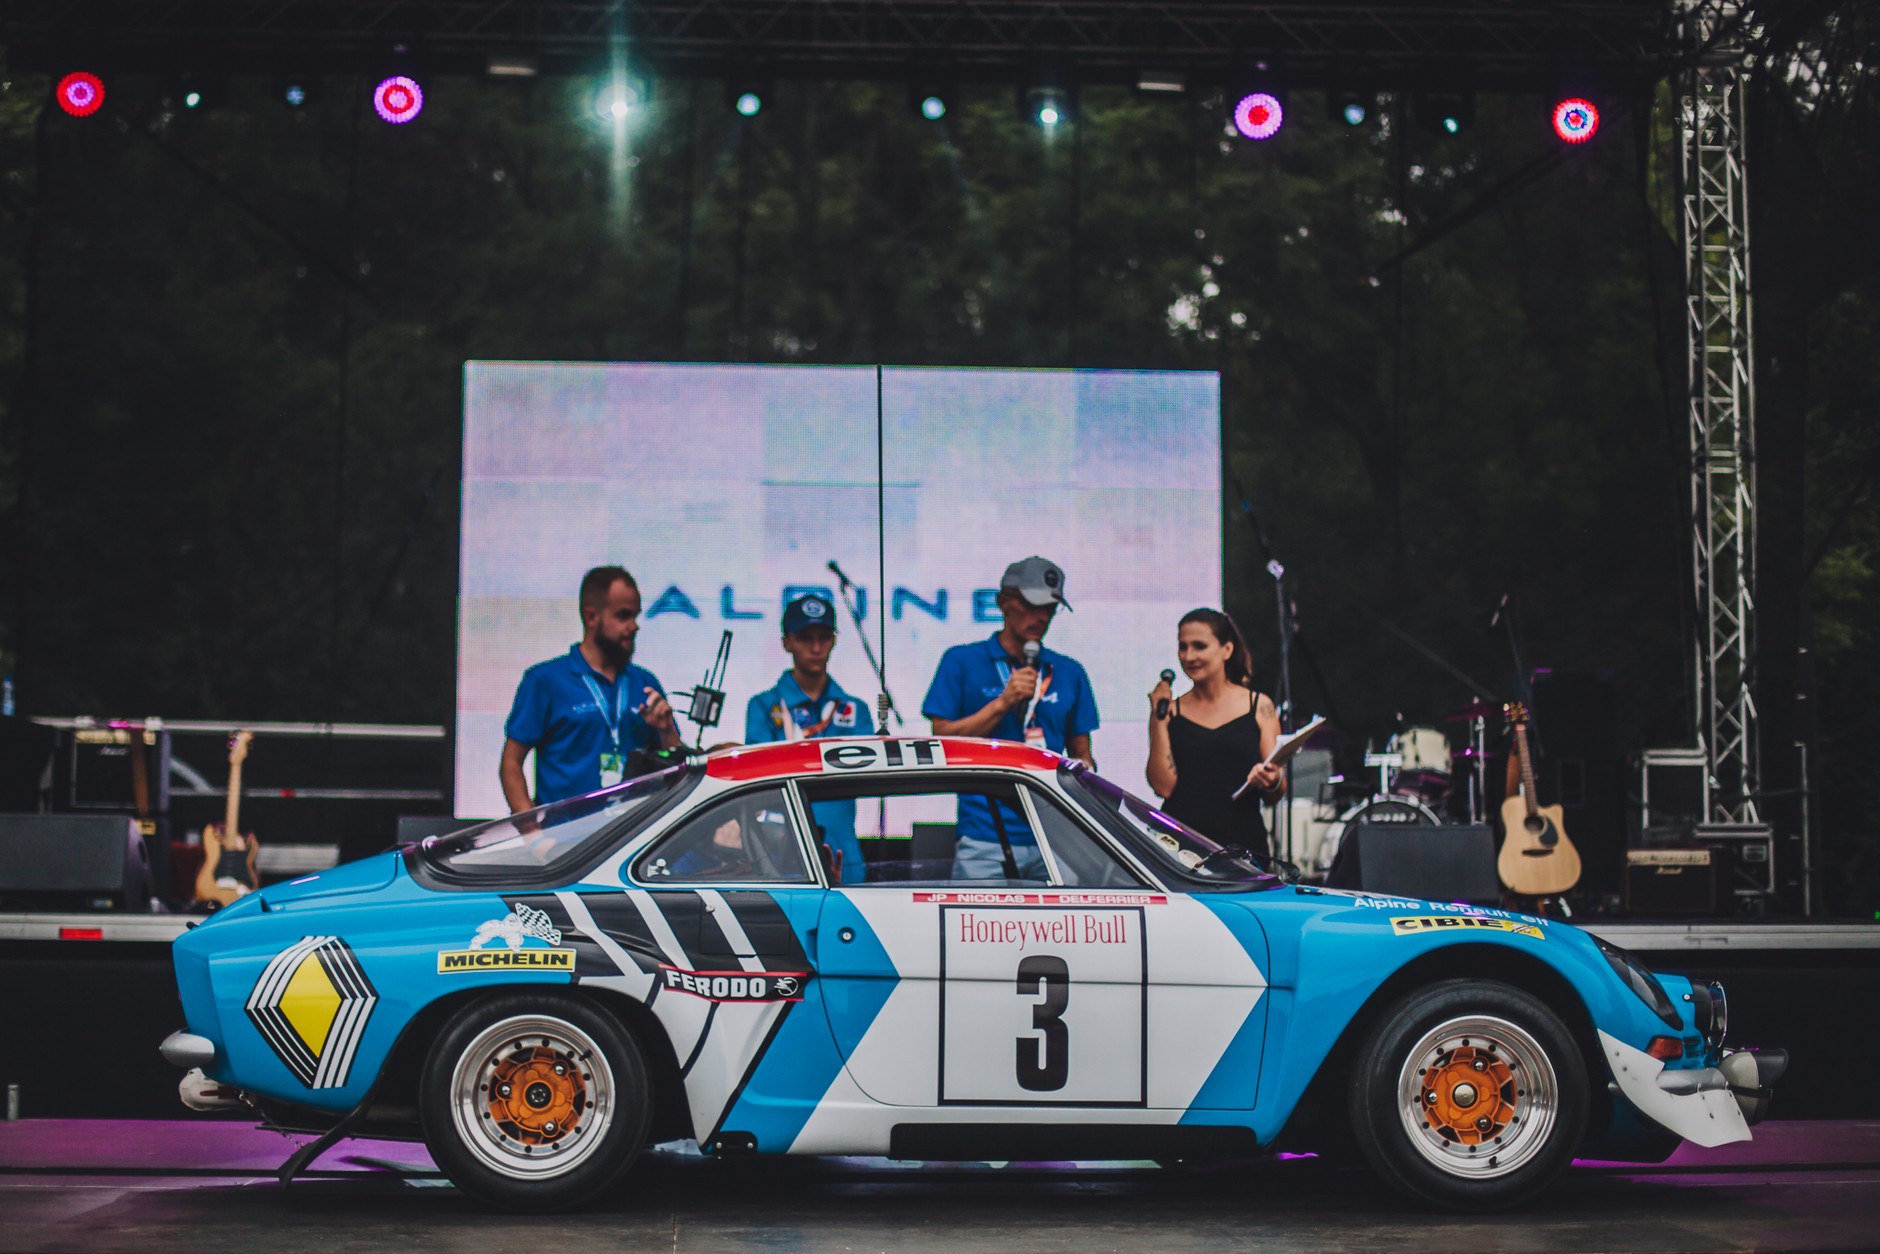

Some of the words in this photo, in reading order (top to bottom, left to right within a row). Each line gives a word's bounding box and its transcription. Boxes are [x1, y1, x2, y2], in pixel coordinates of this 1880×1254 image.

[824, 740, 940, 769] elf
[927, 893, 947, 902] JP
[957, 894, 1025, 904] NICOLAS
[1059, 895, 1151, 904] DELFERRIER
[1354, 898, 1420, 910] Alpine
[1429, 902, 1511, 919] Renault
[960, 913, 1077, 951] Honeywell
[1084, 914, 1126, 944] Bull
[444, 953, 568, 968] MICHELIN
[665, 969, 766, 998] FERODO
[1016, 954, 1069, 1092] 3
